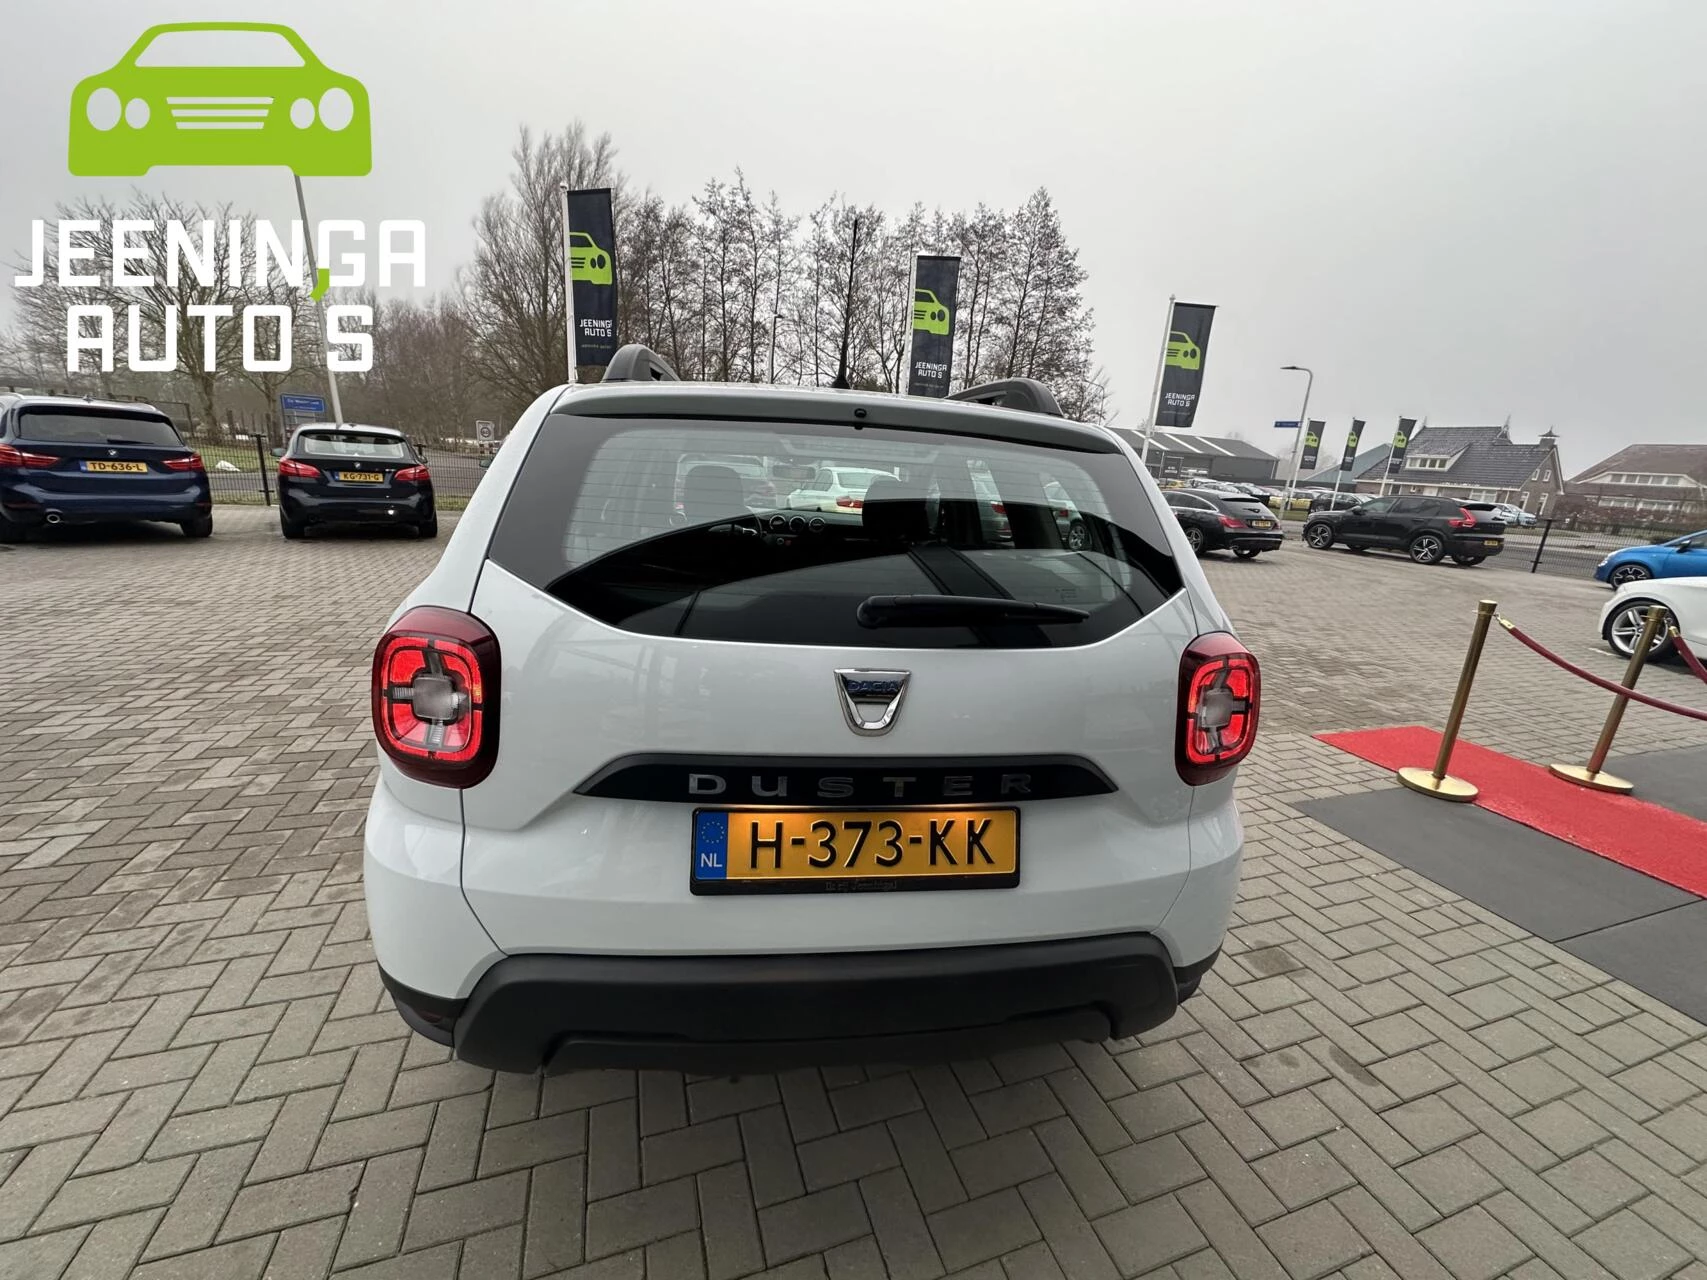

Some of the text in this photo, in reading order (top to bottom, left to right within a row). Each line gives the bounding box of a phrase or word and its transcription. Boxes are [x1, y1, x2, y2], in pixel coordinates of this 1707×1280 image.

[915, 361, 948, 371] JEENINGA
[90, 462, 144, 472] TD-636-L
[848, 681, 898, 692] DACIA
[688, 773, 1032, 798] DUSTER
[701, 818, 996, 870] NL H-373-KK
